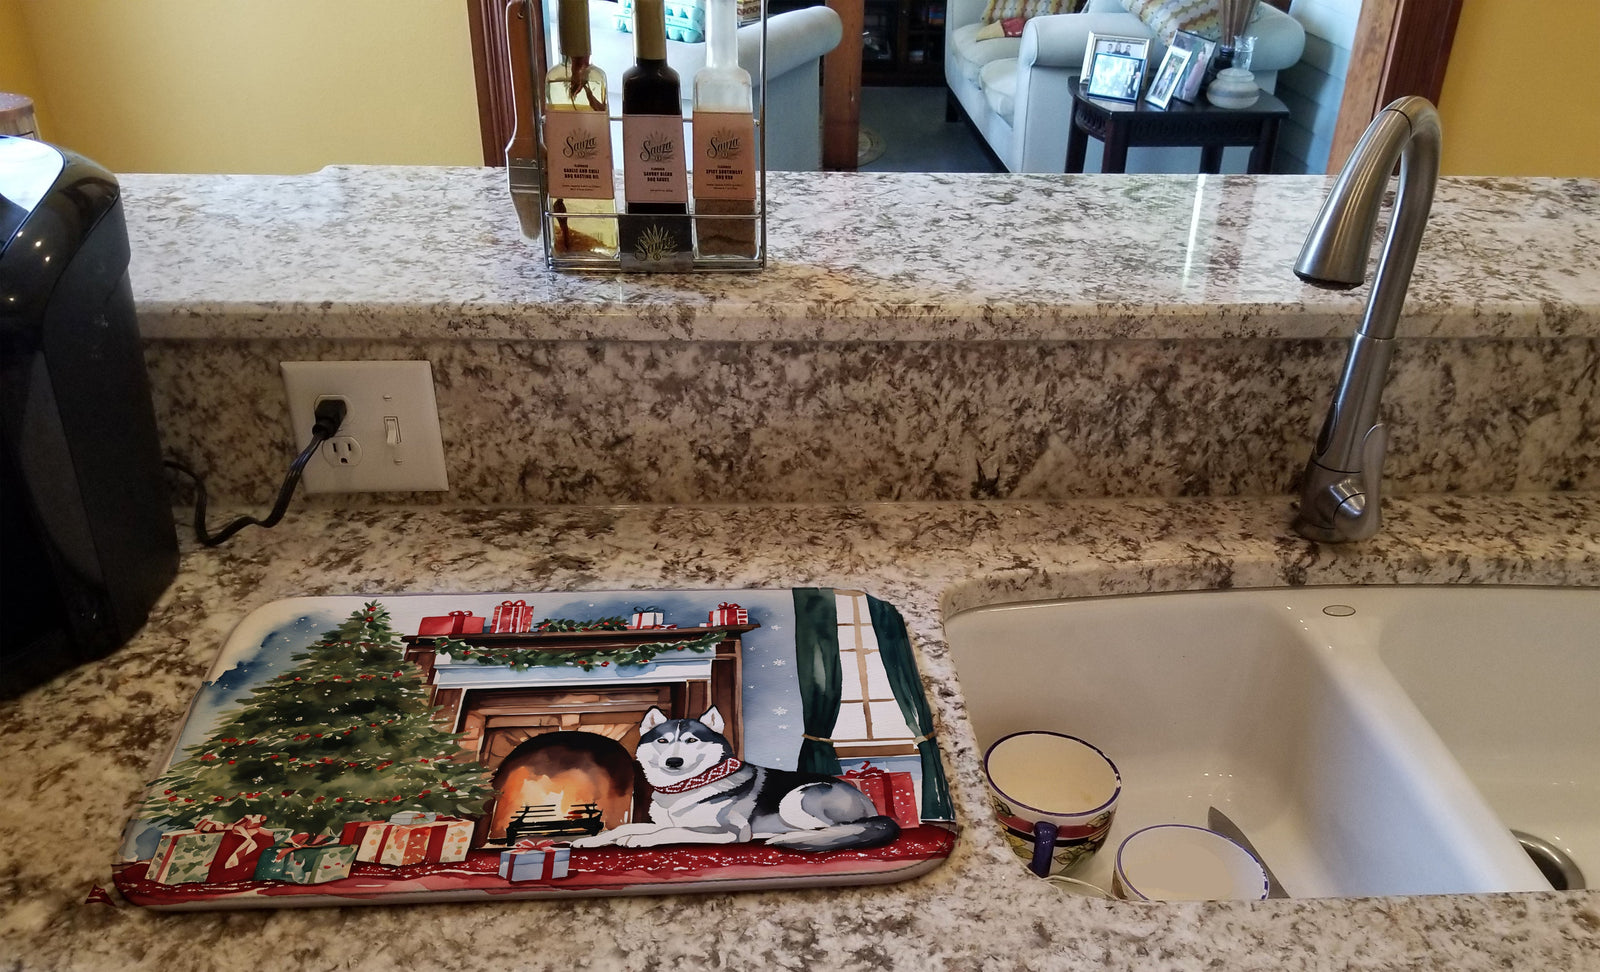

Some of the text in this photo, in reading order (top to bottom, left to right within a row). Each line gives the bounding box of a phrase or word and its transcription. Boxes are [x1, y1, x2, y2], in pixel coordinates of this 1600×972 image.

[563, 136, 597, 159] Sauza
[640, 140, 673, 162] Sauza
[707, 137, 739, 159] Sauza
